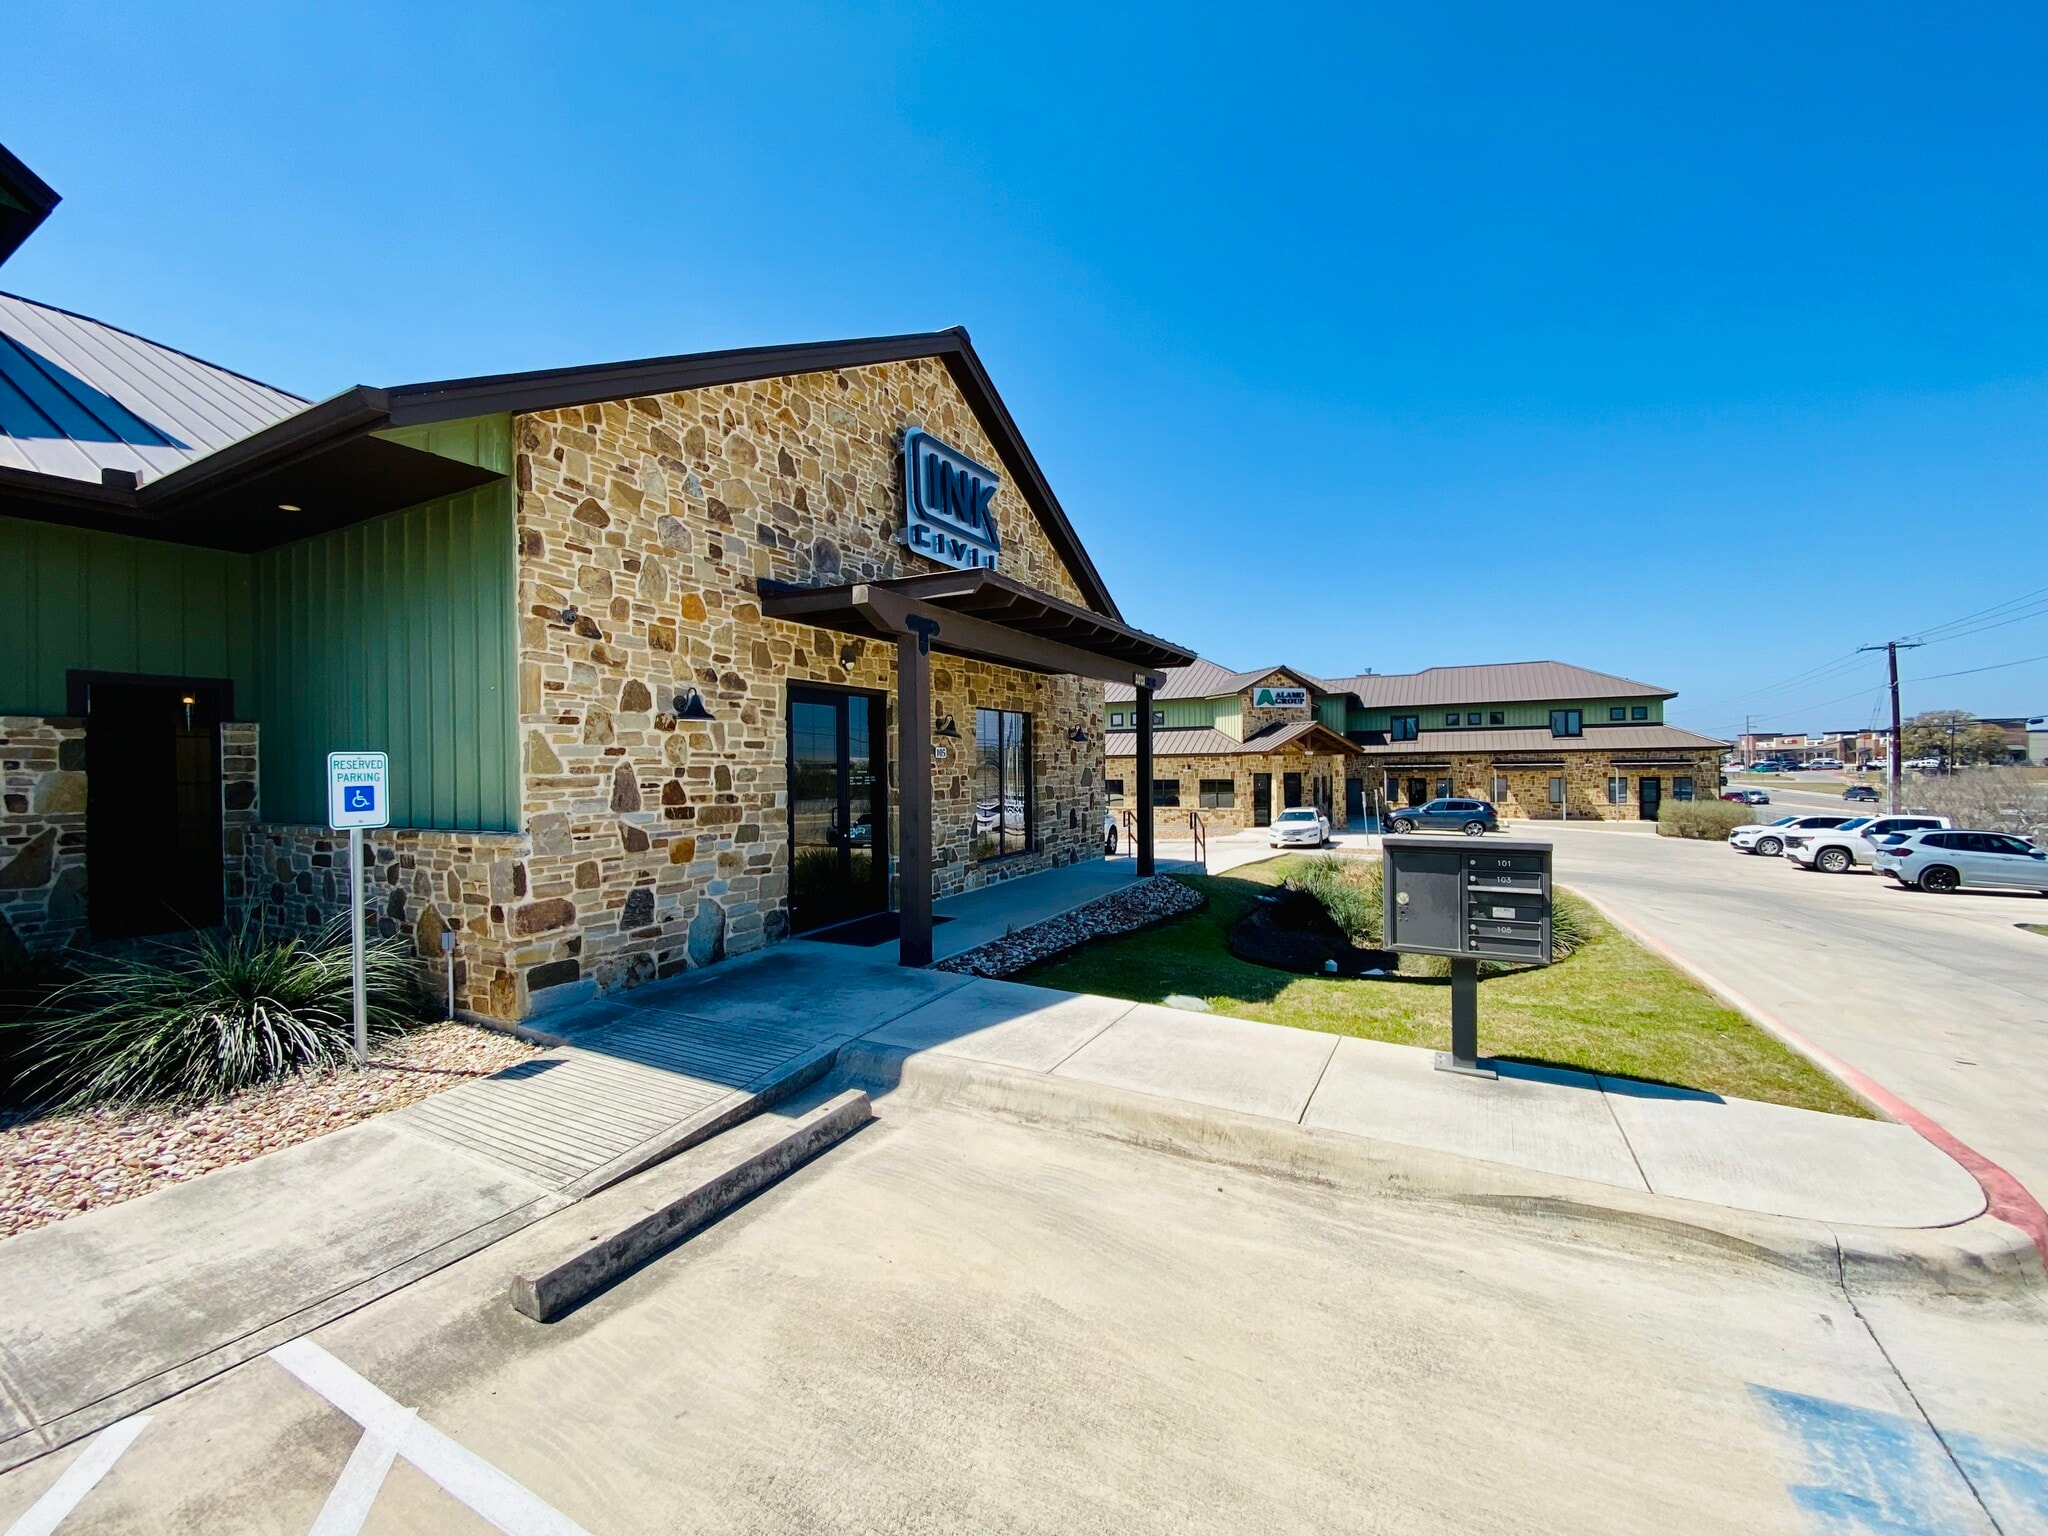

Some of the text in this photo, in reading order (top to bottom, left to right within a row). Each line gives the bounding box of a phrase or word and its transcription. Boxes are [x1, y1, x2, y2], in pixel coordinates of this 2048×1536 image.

[333, 760, 383, 770] RESERVED
[337, 773, 380, 782] PARKING
[1497, 876, 1512, 884] 103
[1497, 926, 1512, 934] 105
